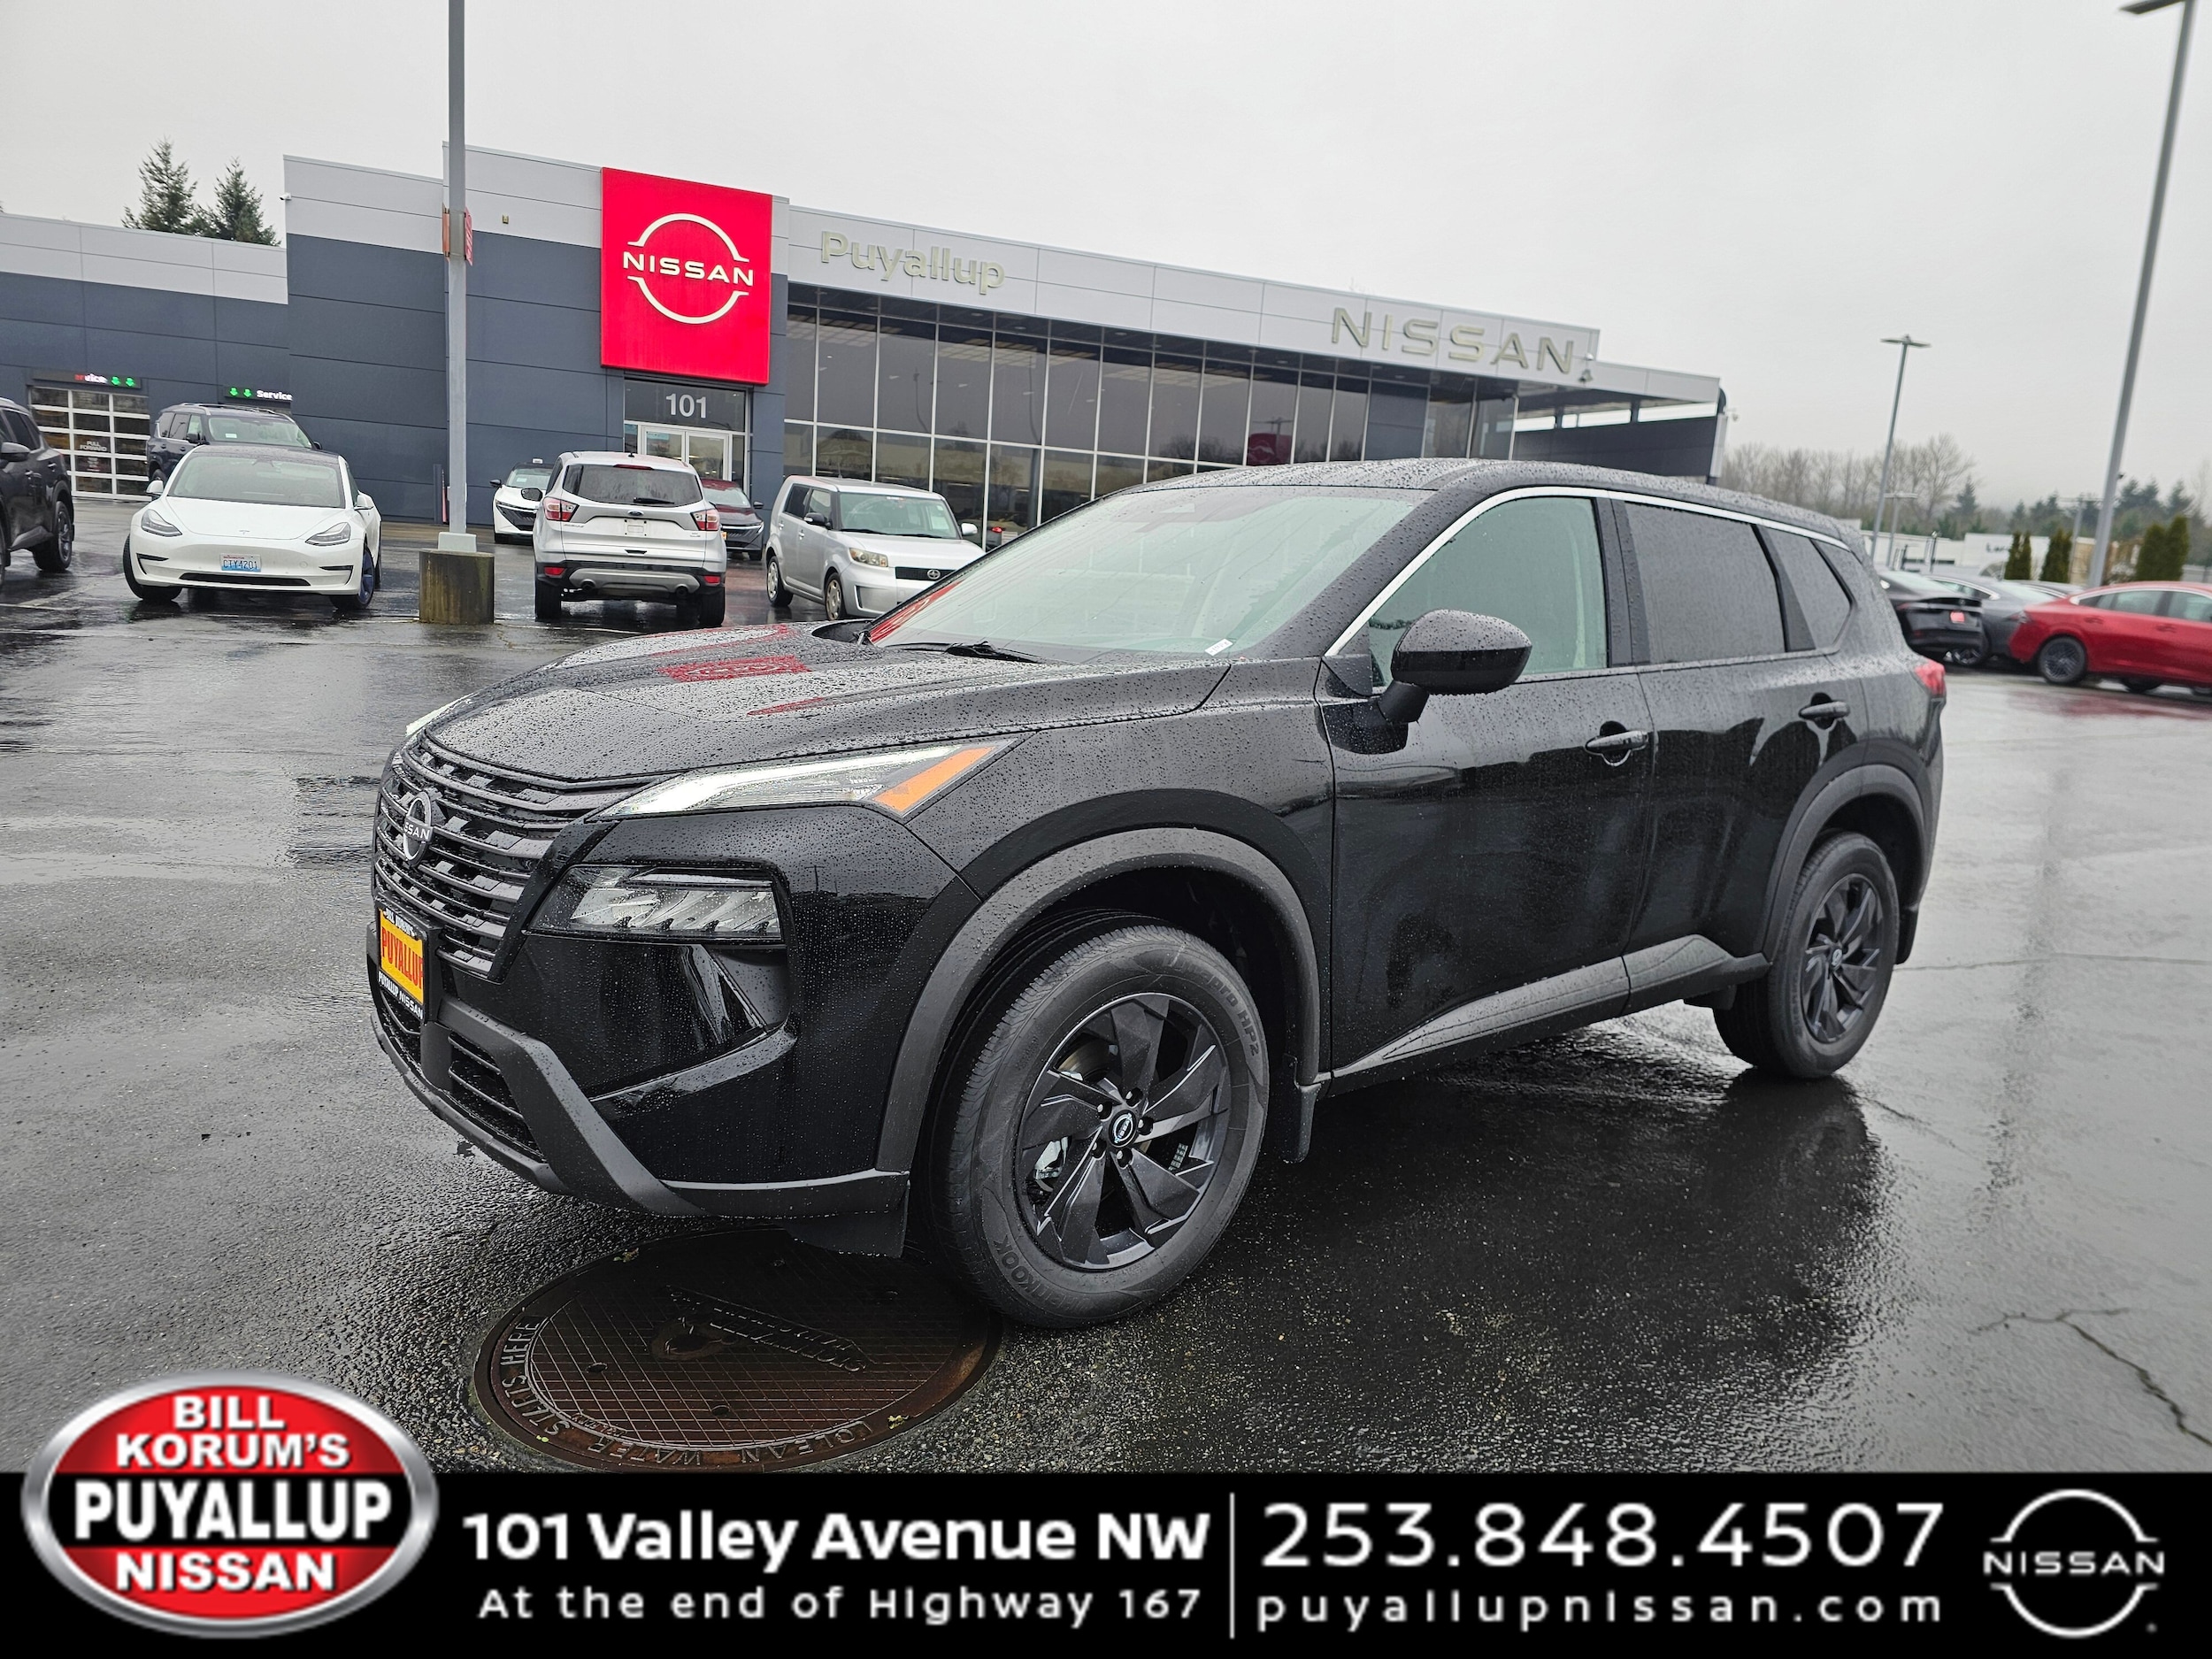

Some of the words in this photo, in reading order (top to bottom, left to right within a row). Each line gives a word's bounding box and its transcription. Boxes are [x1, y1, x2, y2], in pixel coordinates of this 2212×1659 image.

[623, 251, 753, 287] NISSAN
[821, 230, 1005, 296] Puyallup
[1332, 307, 1575, 374] NISSAN
[256, 389, 293, 401] Service
[665, 393, 706, 419] 101
[381, 926, 424, 990] PUYALLUP
[399, 990, 424, 1020] NISSAN
[499, 1320, 541, 1367] HERE
[587, 1434, 703, 1467] WATER
